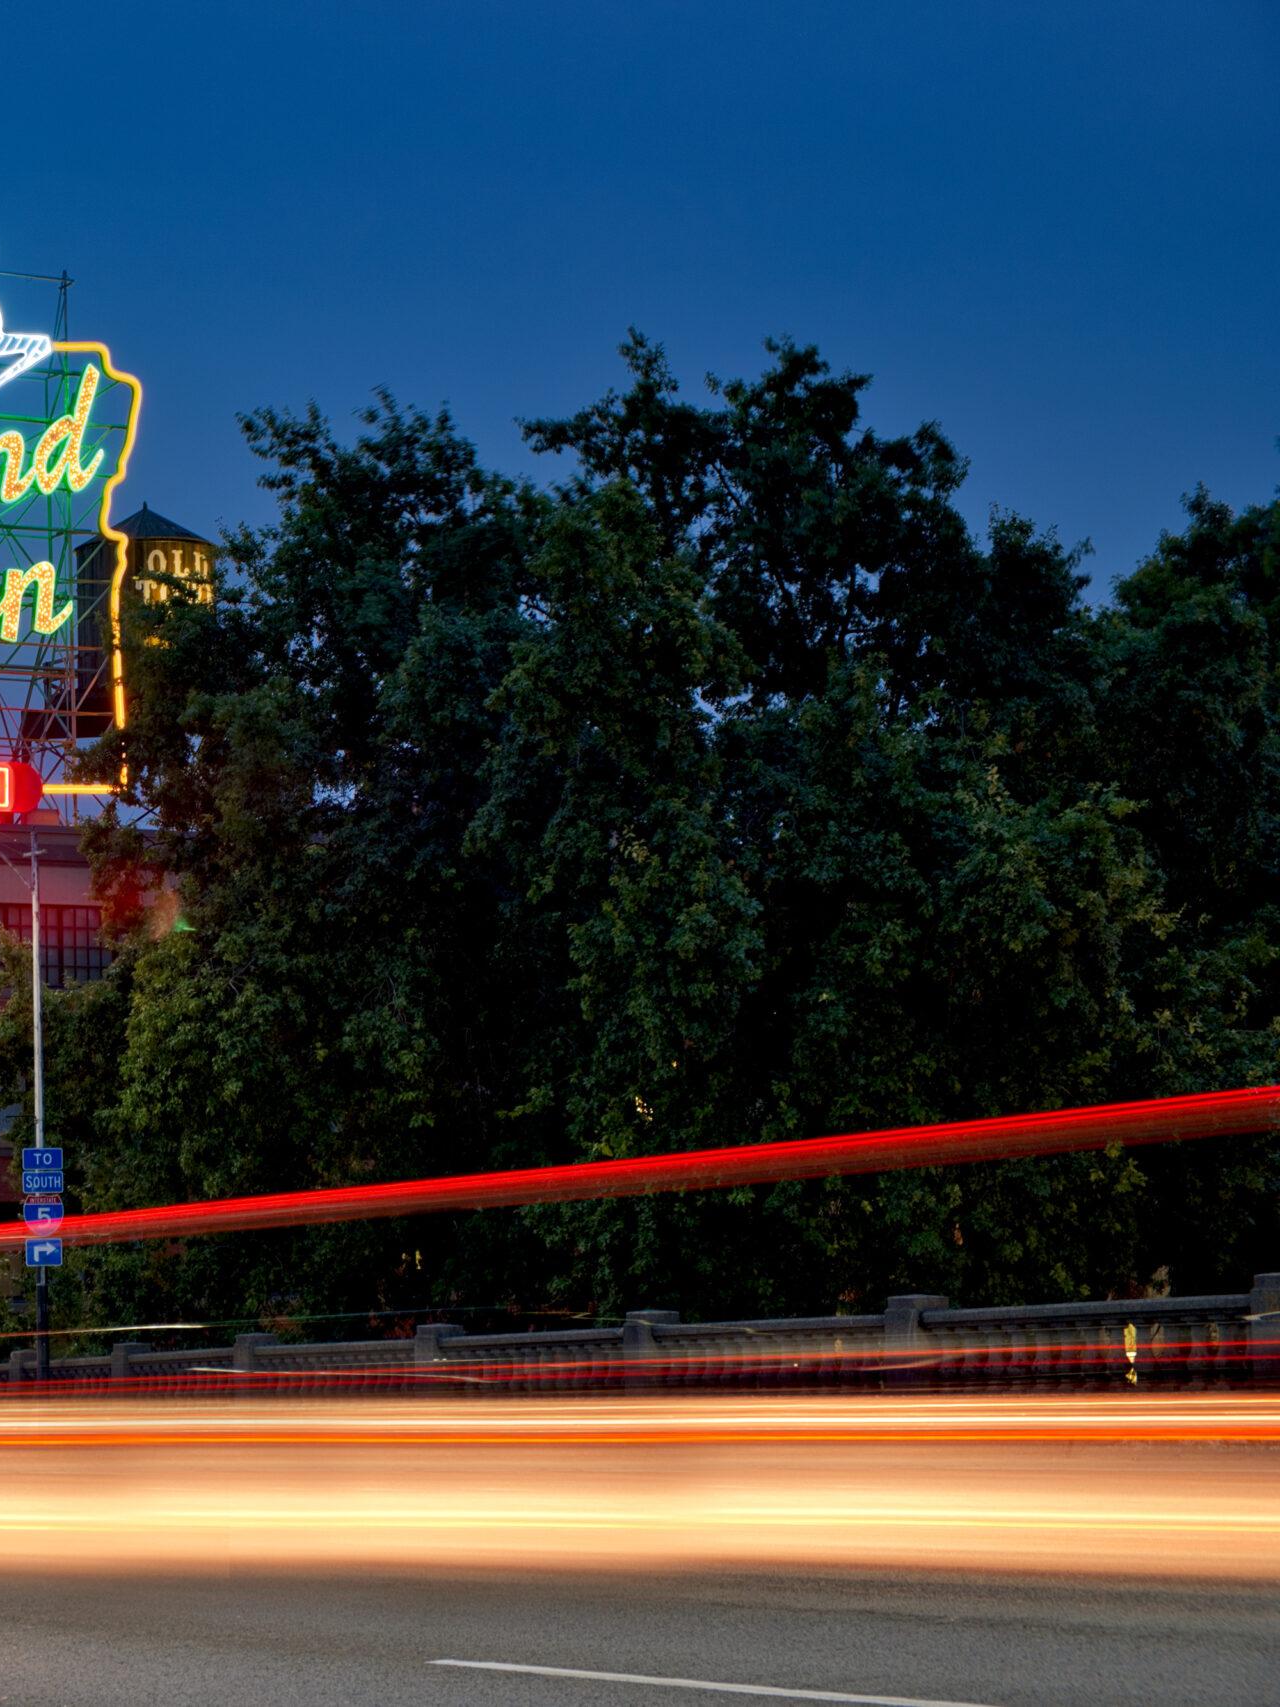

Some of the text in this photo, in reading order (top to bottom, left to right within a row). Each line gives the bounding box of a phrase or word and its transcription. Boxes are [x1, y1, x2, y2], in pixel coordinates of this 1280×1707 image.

[148, 549, 208, 579] OLD
[34, 1154, 52, 1165] TO
[26, 1175, 61, 1188] SOUTH
[38, 1207, 51, 1228] 5
